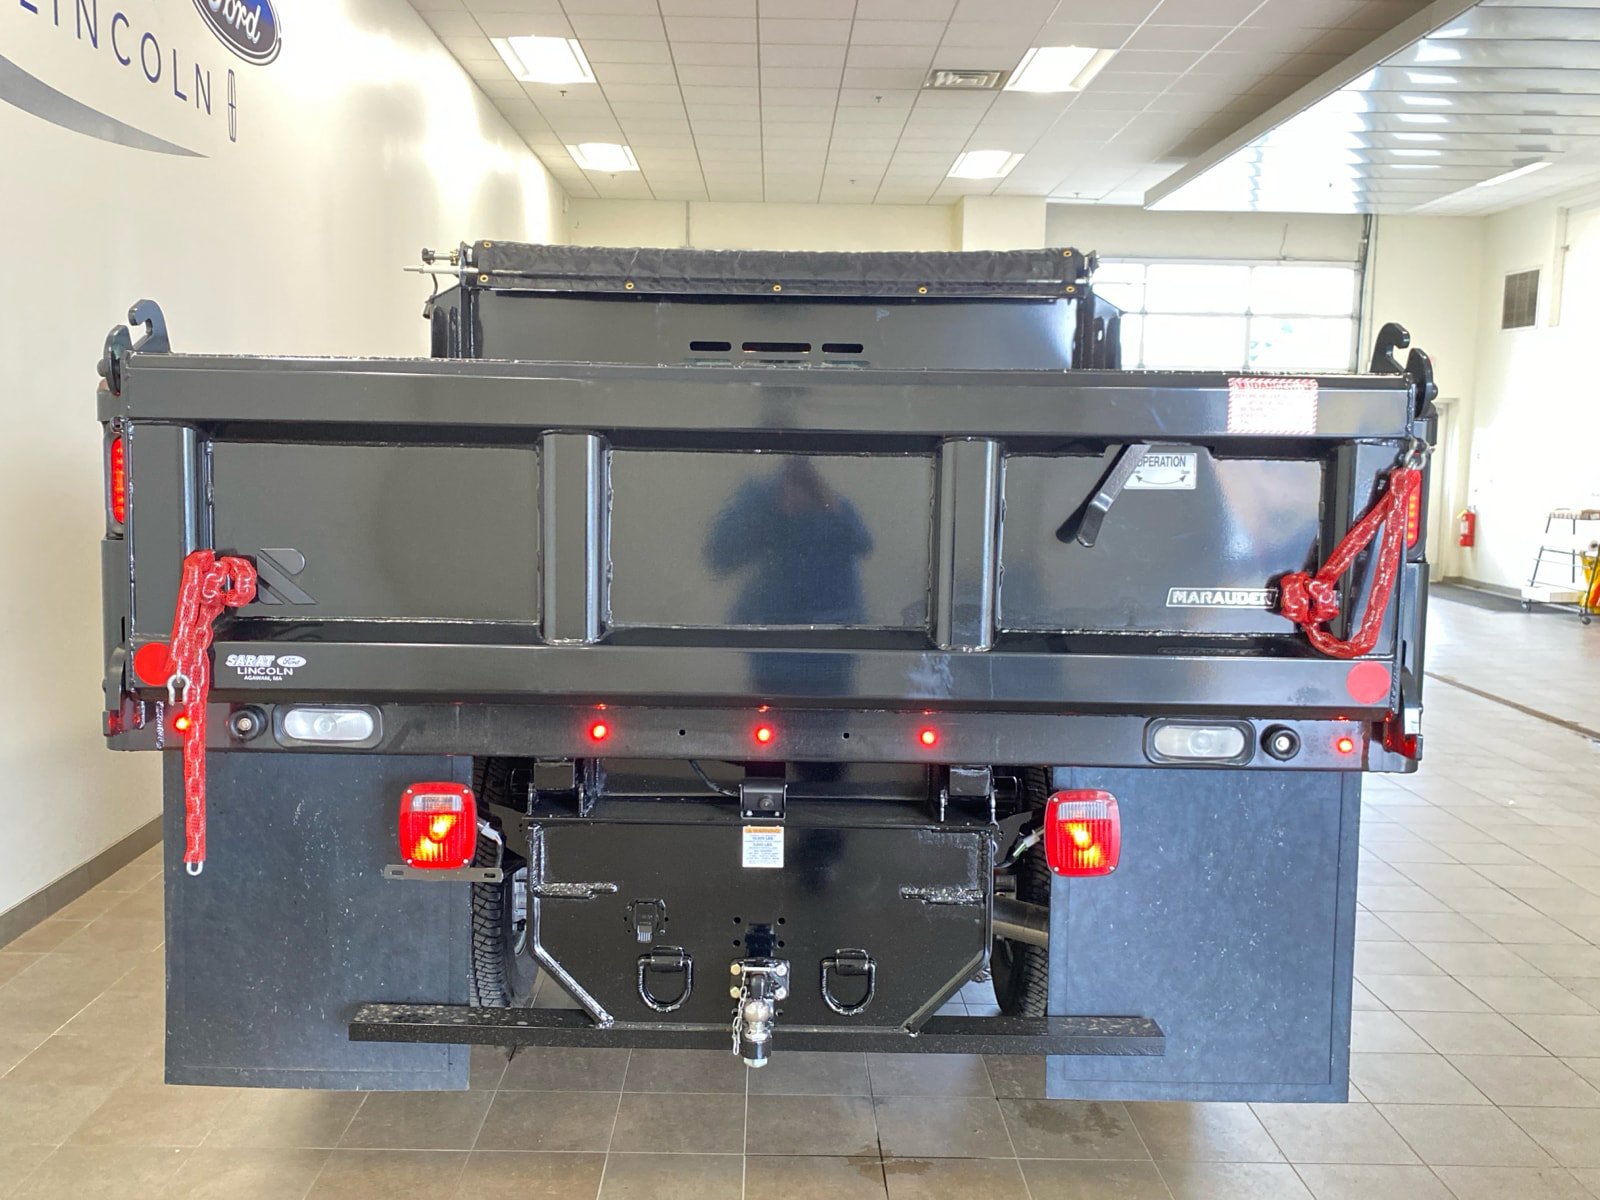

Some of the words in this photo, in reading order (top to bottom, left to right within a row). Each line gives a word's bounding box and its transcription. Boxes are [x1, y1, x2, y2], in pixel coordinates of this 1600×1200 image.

[208, 0, 261, 44] ord
[19, 0, 211, 116] INCOLN
[225, 654, 275, 667] SARAT
[237, 667, 294, 676] LINCOLN
